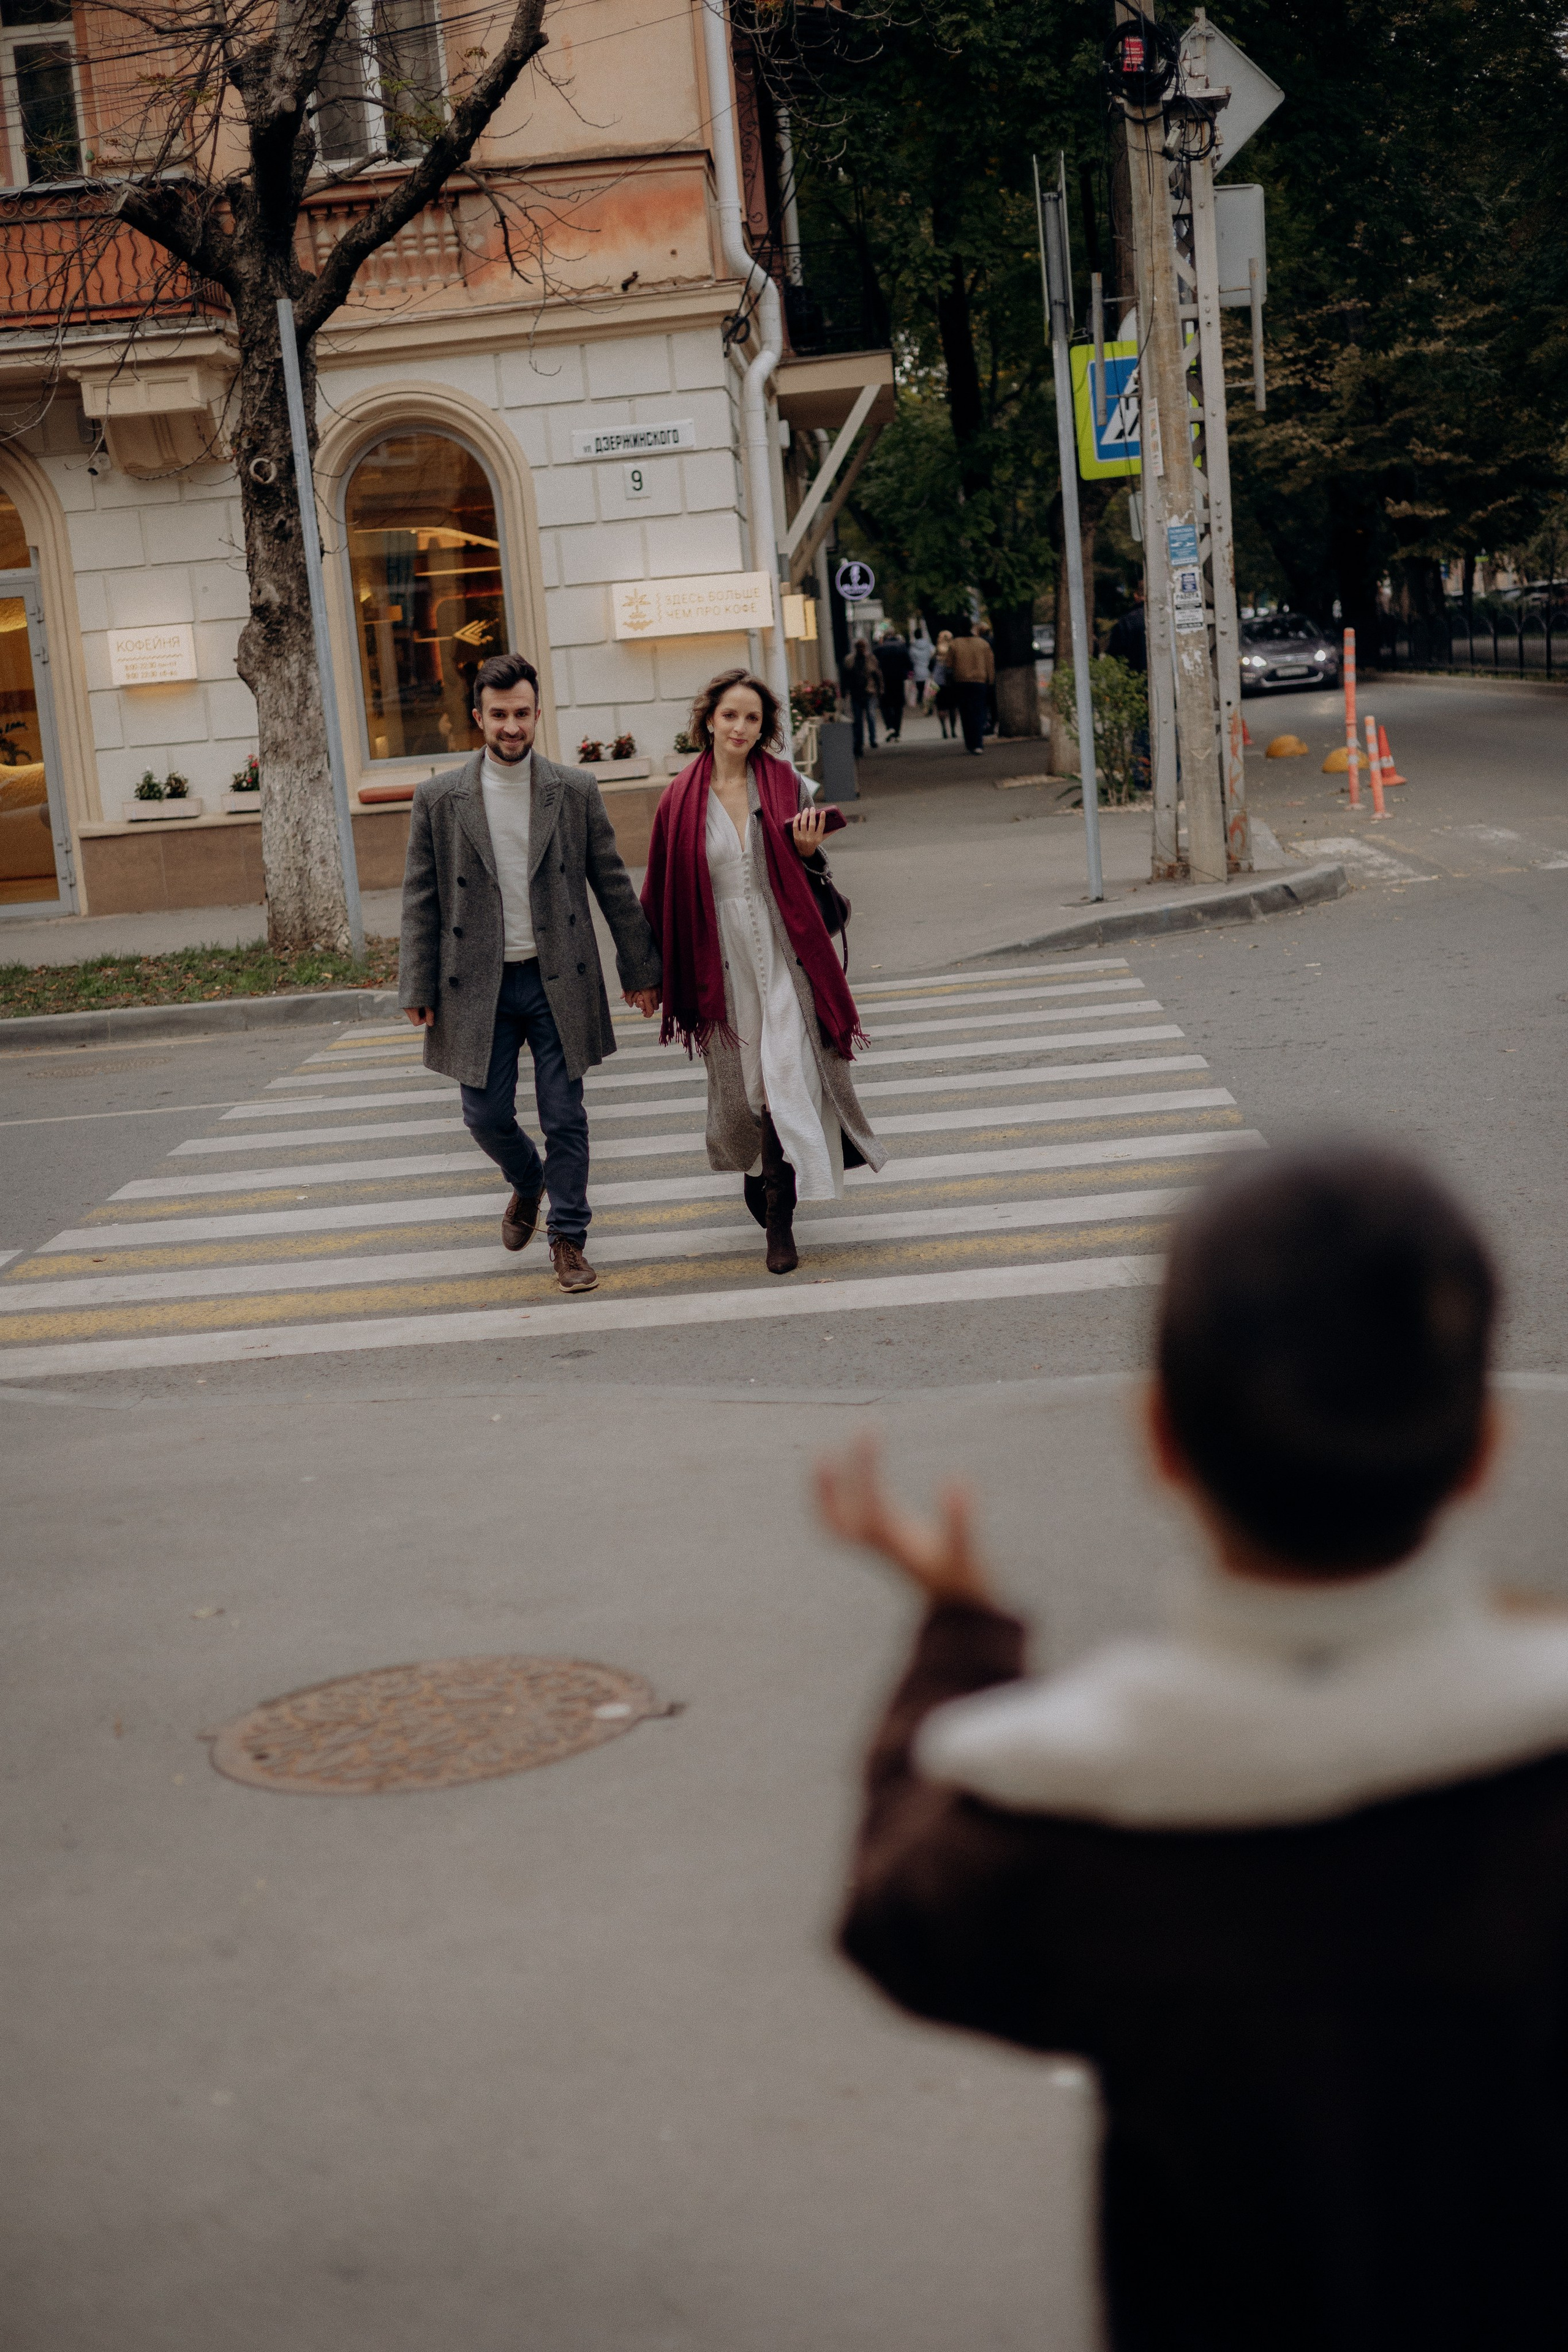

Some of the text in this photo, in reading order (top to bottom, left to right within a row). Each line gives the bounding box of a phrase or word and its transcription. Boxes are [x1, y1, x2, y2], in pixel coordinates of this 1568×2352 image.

[595, 429, 679, 453] ДЗЕРЖИНСКОГО
[631, 470, 643, 491] 9
[665, 587, 760, 606] ЗДЕСЬ БОЛЬШЕ
[666, 602, 758, 619] ЧЕМ ПРО КОФЕ
[116, 635, 181, 652] КОФЕЙНЯ
